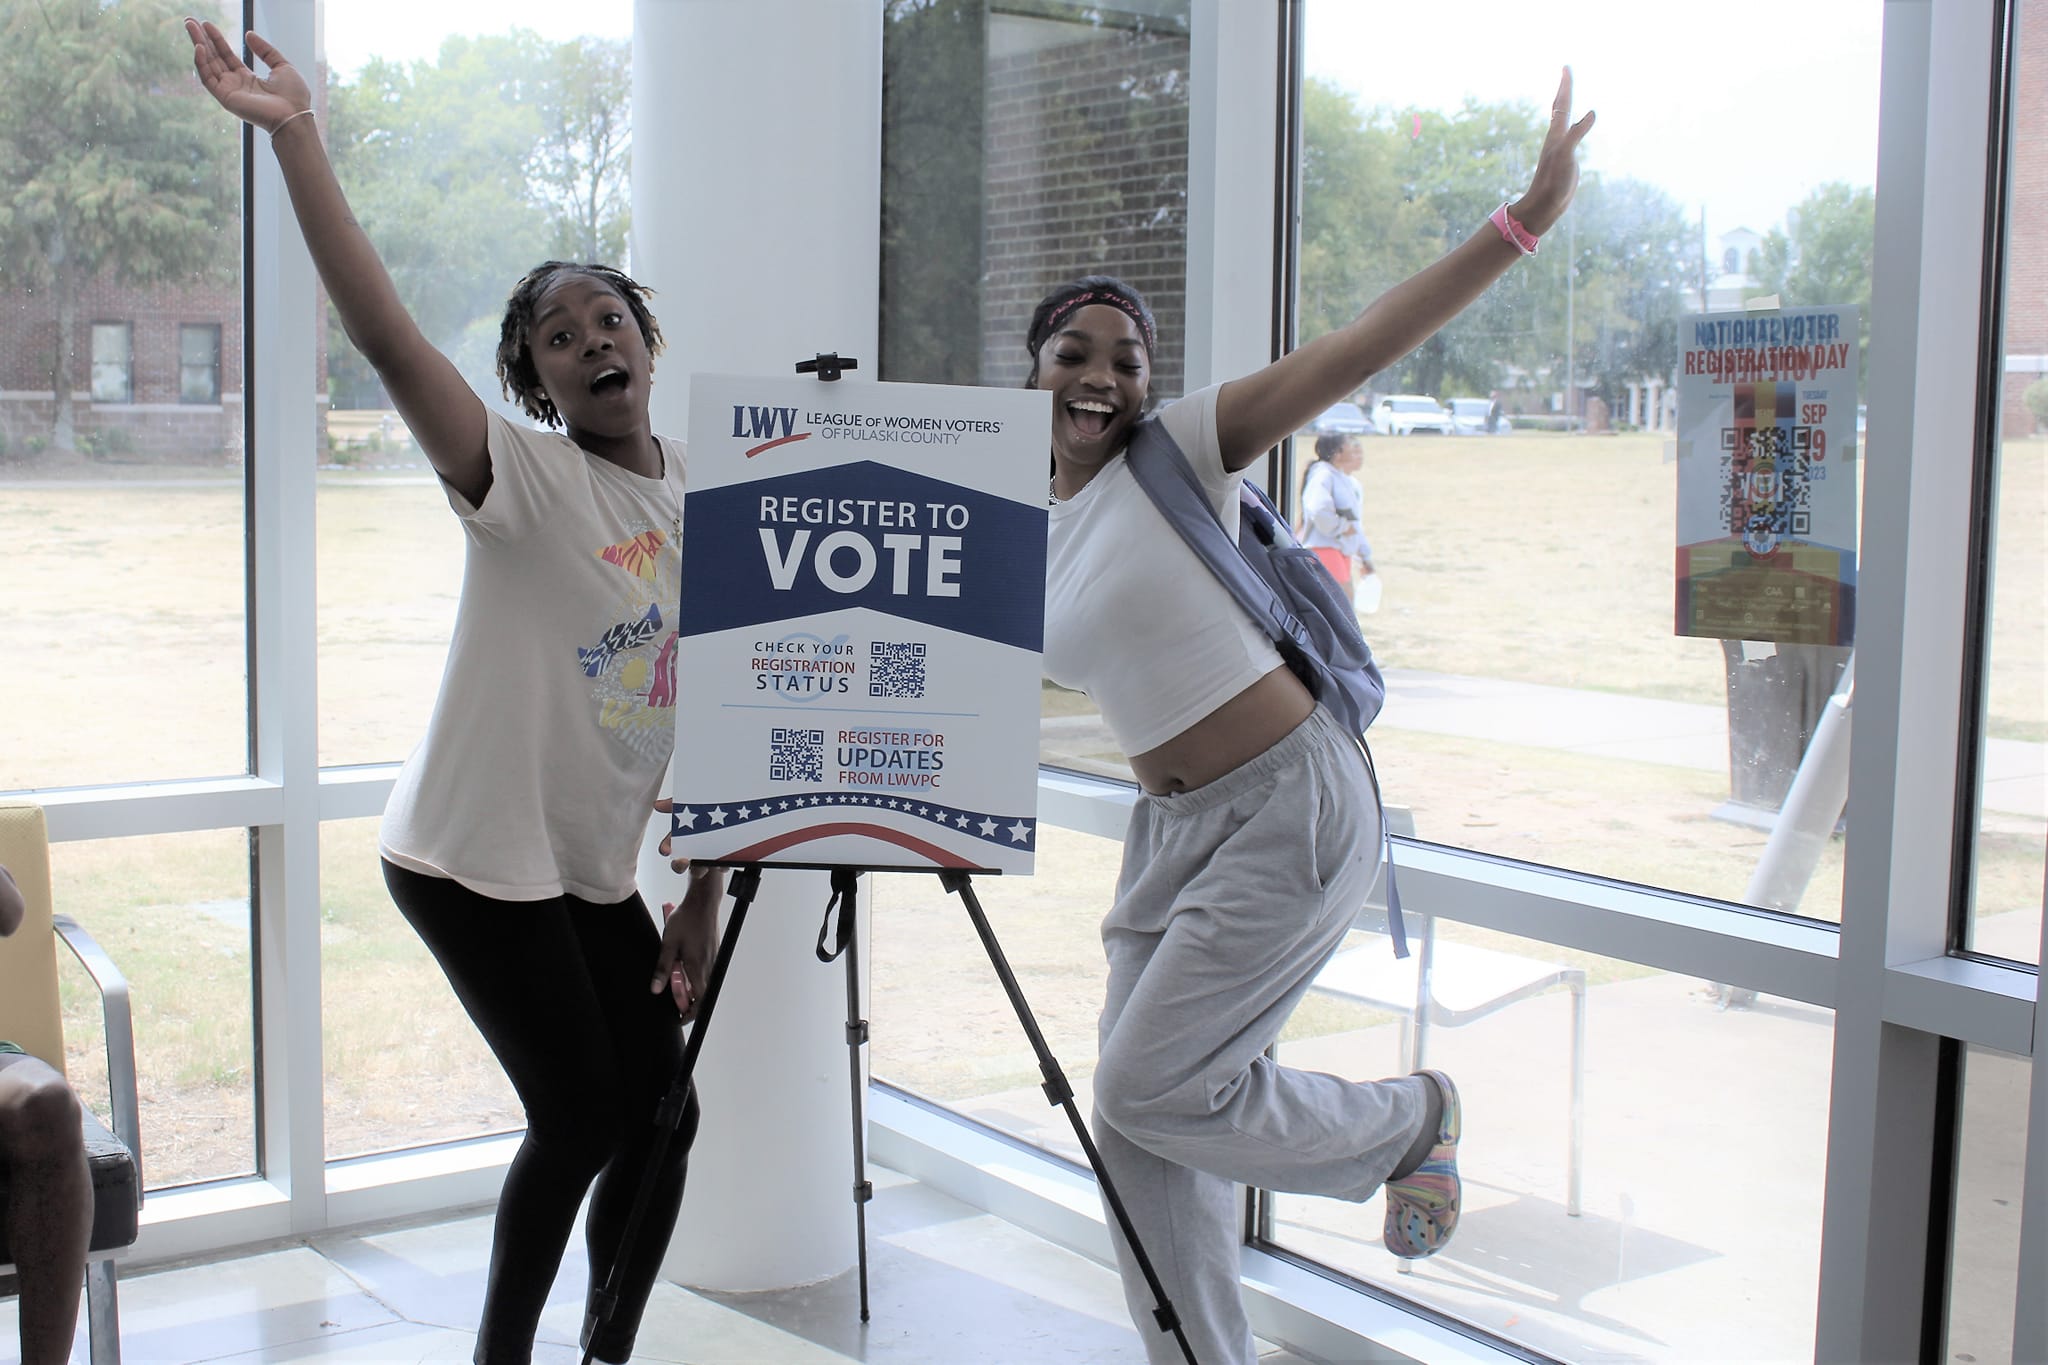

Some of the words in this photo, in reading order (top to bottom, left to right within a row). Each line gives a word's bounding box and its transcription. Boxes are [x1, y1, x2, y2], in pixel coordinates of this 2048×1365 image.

[1783, 314, 1839, 342] VOTER
[1685, 345, 1809, 375] REGISTRATION
[1815, 344, 1850, 369] DAY
[731, 405, 799, 440] LWV
[806, 412, 863, 427] LEAGUE
[884, 416, 942, 430] WOMEN
[1802, 404, 1827, 424] SEP
[821, 427, 842, 440] OF
[843, 428, 898, 443] PULASKI
[900, 431, 961, 445] COUNTY
[760, 495, 917, 528] REGISTER
[926, 503, 970, 530] TO
[758, 527, 963, 598] VOTE
[754, 641, 805, 654] CHECK
[813, 643, 854, 656] YOUR
[751, 657, 855, 674] REGISTRATION
[756, 674, 849, 693] STATUS
[838, 730, 909, 746] REGISTER
[914, 733, 944, 747] FOR
[837, 747, 944, 771] UPDATES
[839, 771, 883, 785] FROM
[887, 773, 941, 788] LWVPC
